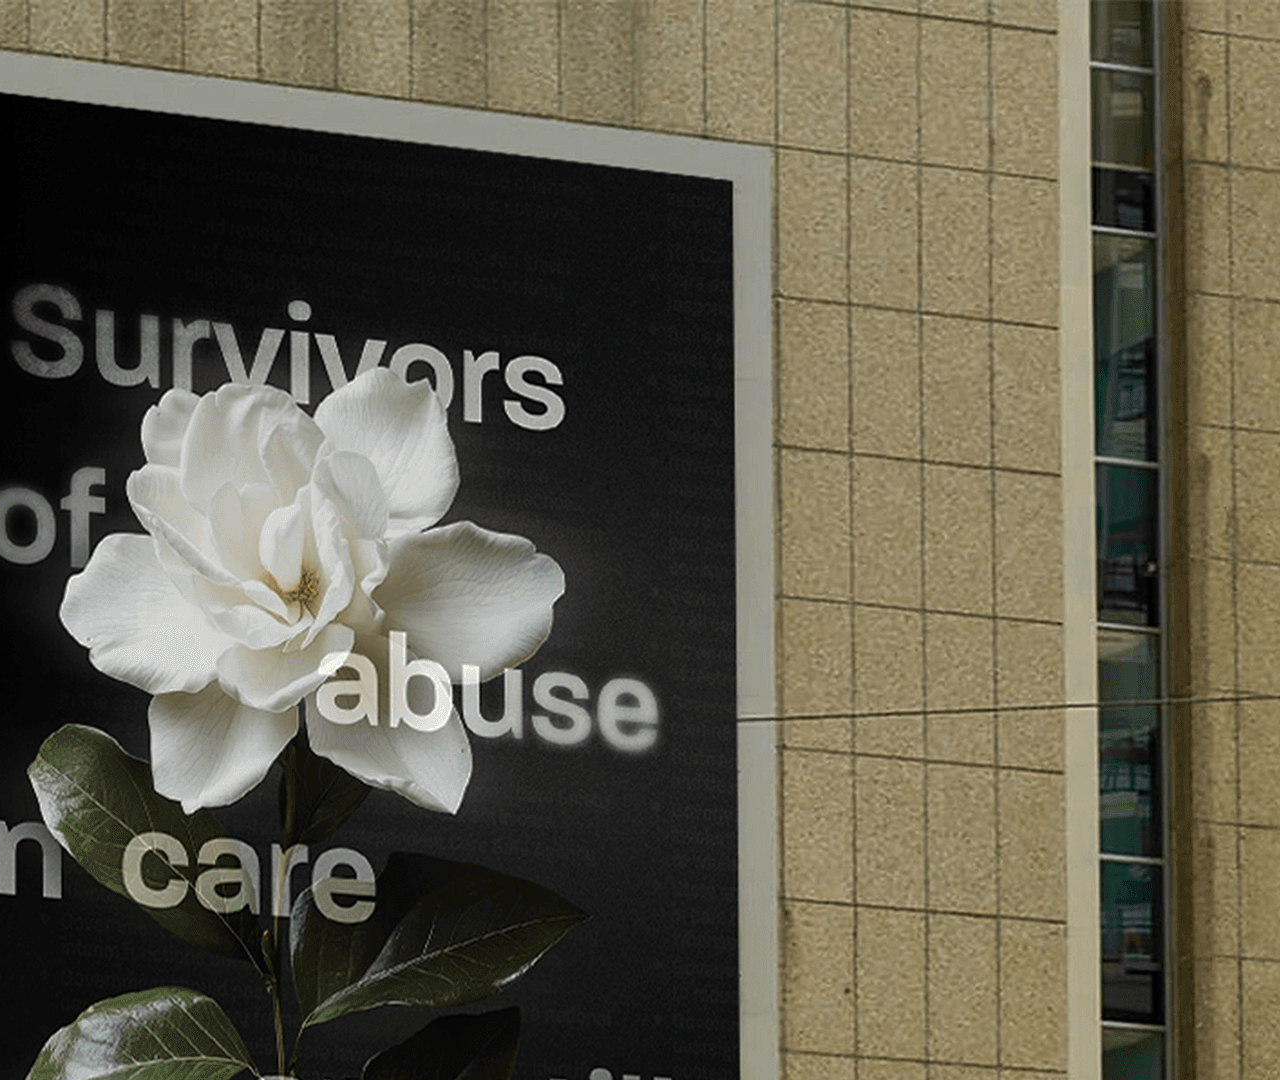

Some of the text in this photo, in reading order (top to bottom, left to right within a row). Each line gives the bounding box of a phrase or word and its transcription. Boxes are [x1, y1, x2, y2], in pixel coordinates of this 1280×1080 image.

[12, 283, 565, 431] Survivors
[316, 631, 660, 752] abuse
[121, 831, 377, 924] care
